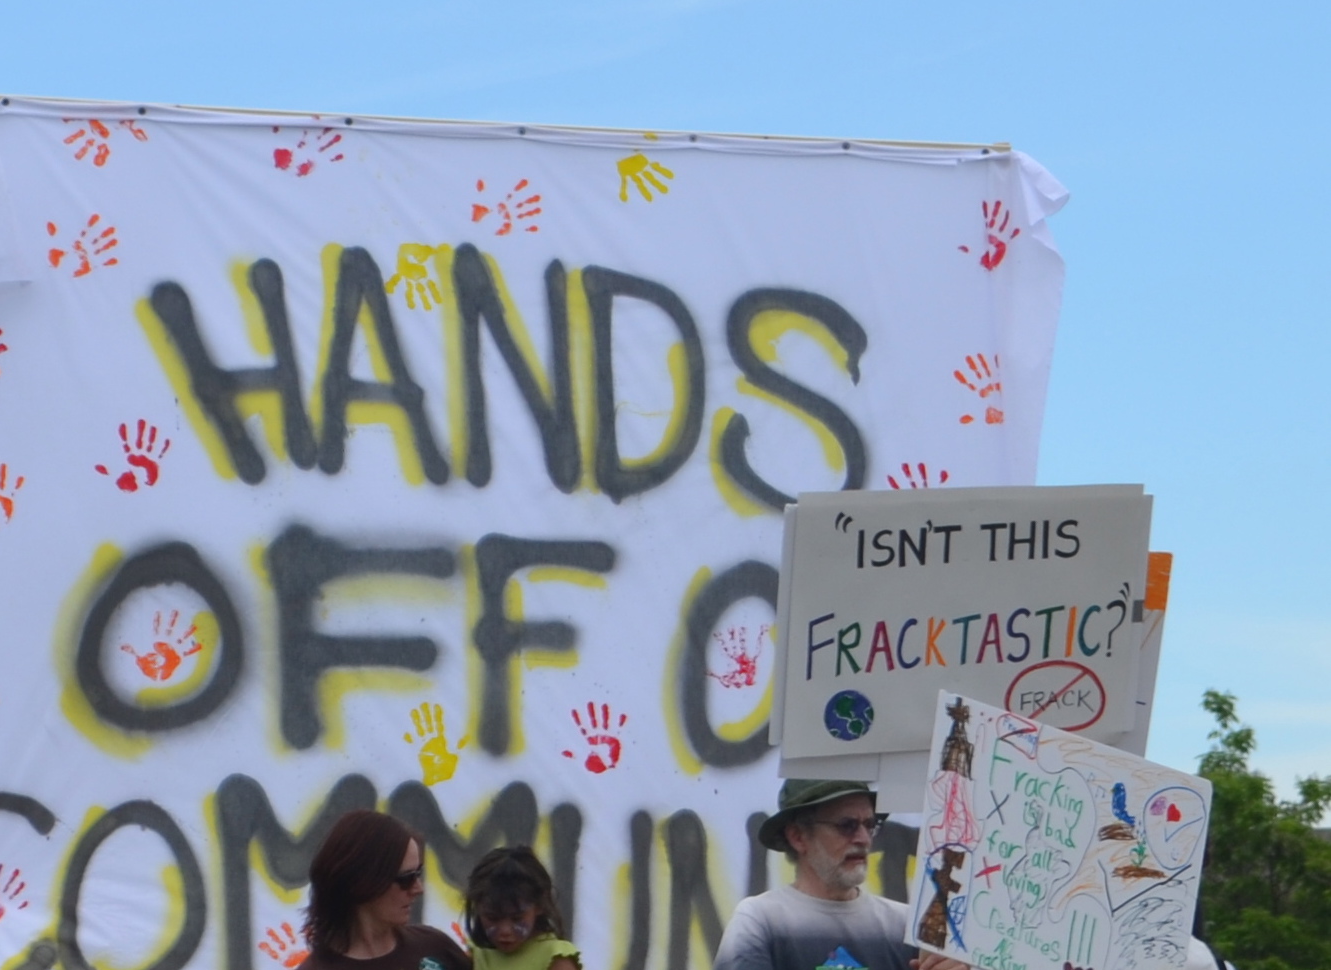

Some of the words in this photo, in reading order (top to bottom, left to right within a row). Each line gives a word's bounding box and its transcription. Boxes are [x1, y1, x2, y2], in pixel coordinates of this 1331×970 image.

[142, 242, 868, 513] HANDS
[979, 518, 1081, 562] THIS
[70, 522, 617, 757] OFF
[673, 556, 781, 769] O
[1019, 689, 1096, 713] FRACK
[986, 829, 1023, 860] for
[1031, 848, 1054, 873] all
[1044, 811, 1076, 849] bad
